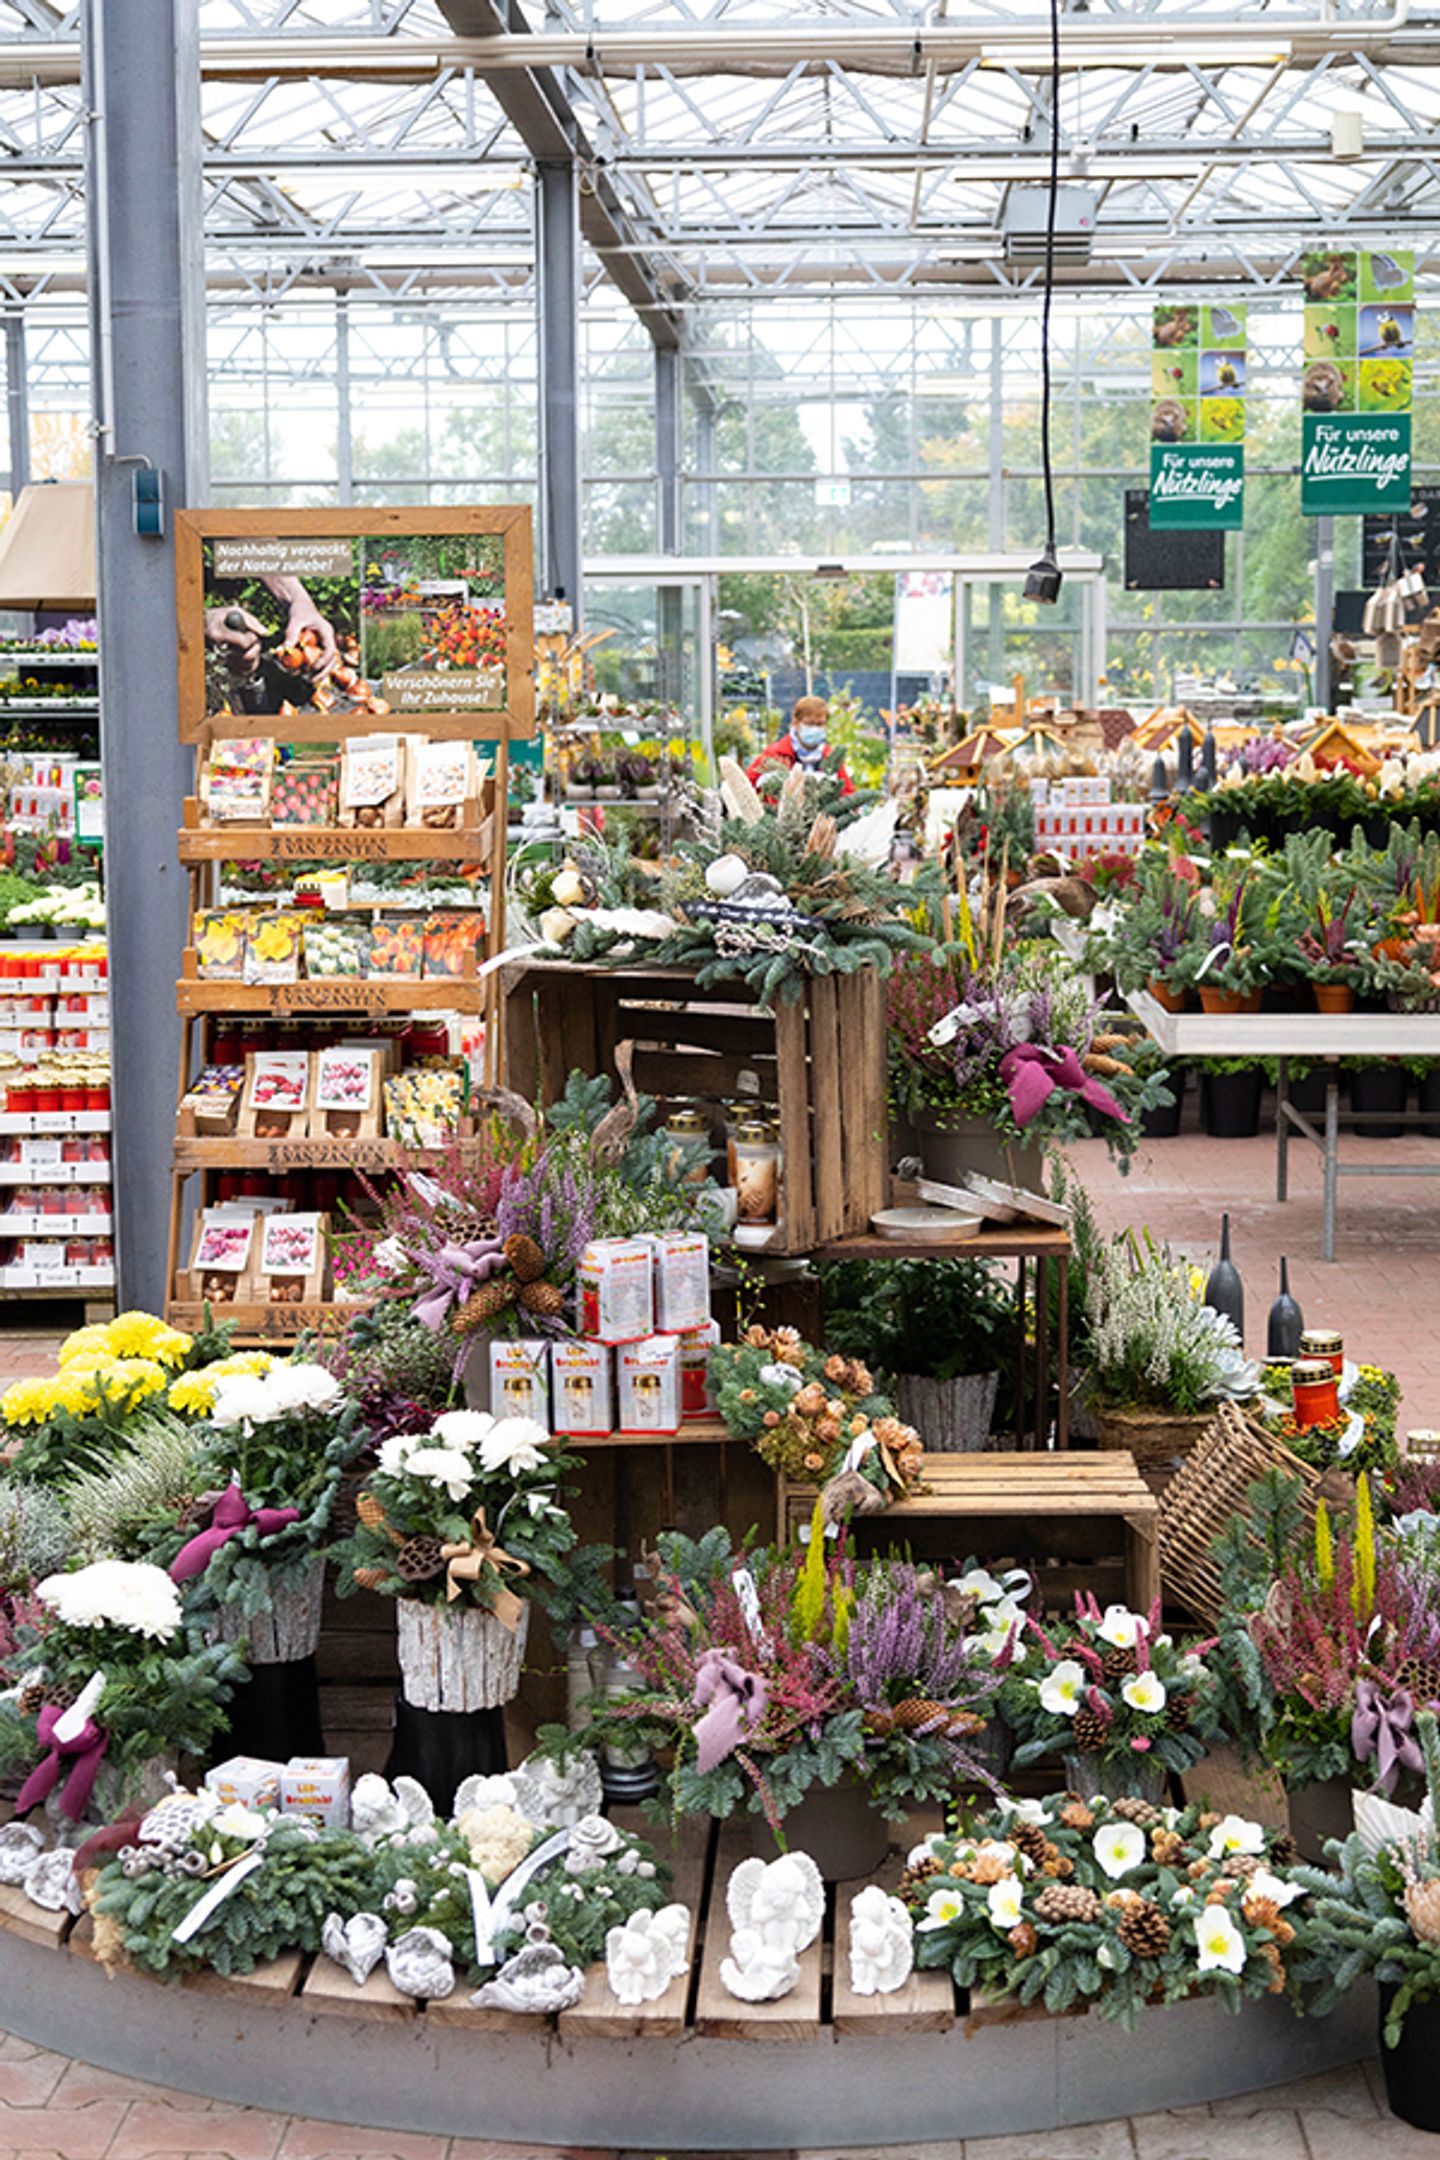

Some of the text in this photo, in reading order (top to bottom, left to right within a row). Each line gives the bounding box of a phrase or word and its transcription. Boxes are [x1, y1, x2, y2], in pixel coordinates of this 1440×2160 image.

[1315, 424, 1400, 442] Für unsere
[1162, 453, 1235, 469] Für unsere
[1304, 443, 1410, 490] Nützlinge
[1152, 469, 1243, 510] Nützlinge
[217, 543, 288, 559] Nachhaltig
[218, 559, 334, 573] der Natur zuliebe!
[386, 674, 496, 690] Verschönern Sie
[401, 690, 489, 705] Ihr Zuhause!
[286, 844, 387, 855] VAN ZANTEN
[285, 995, 315, 1005] VAN
[283, 1151, 384, 1162] VAN ZANTEN
